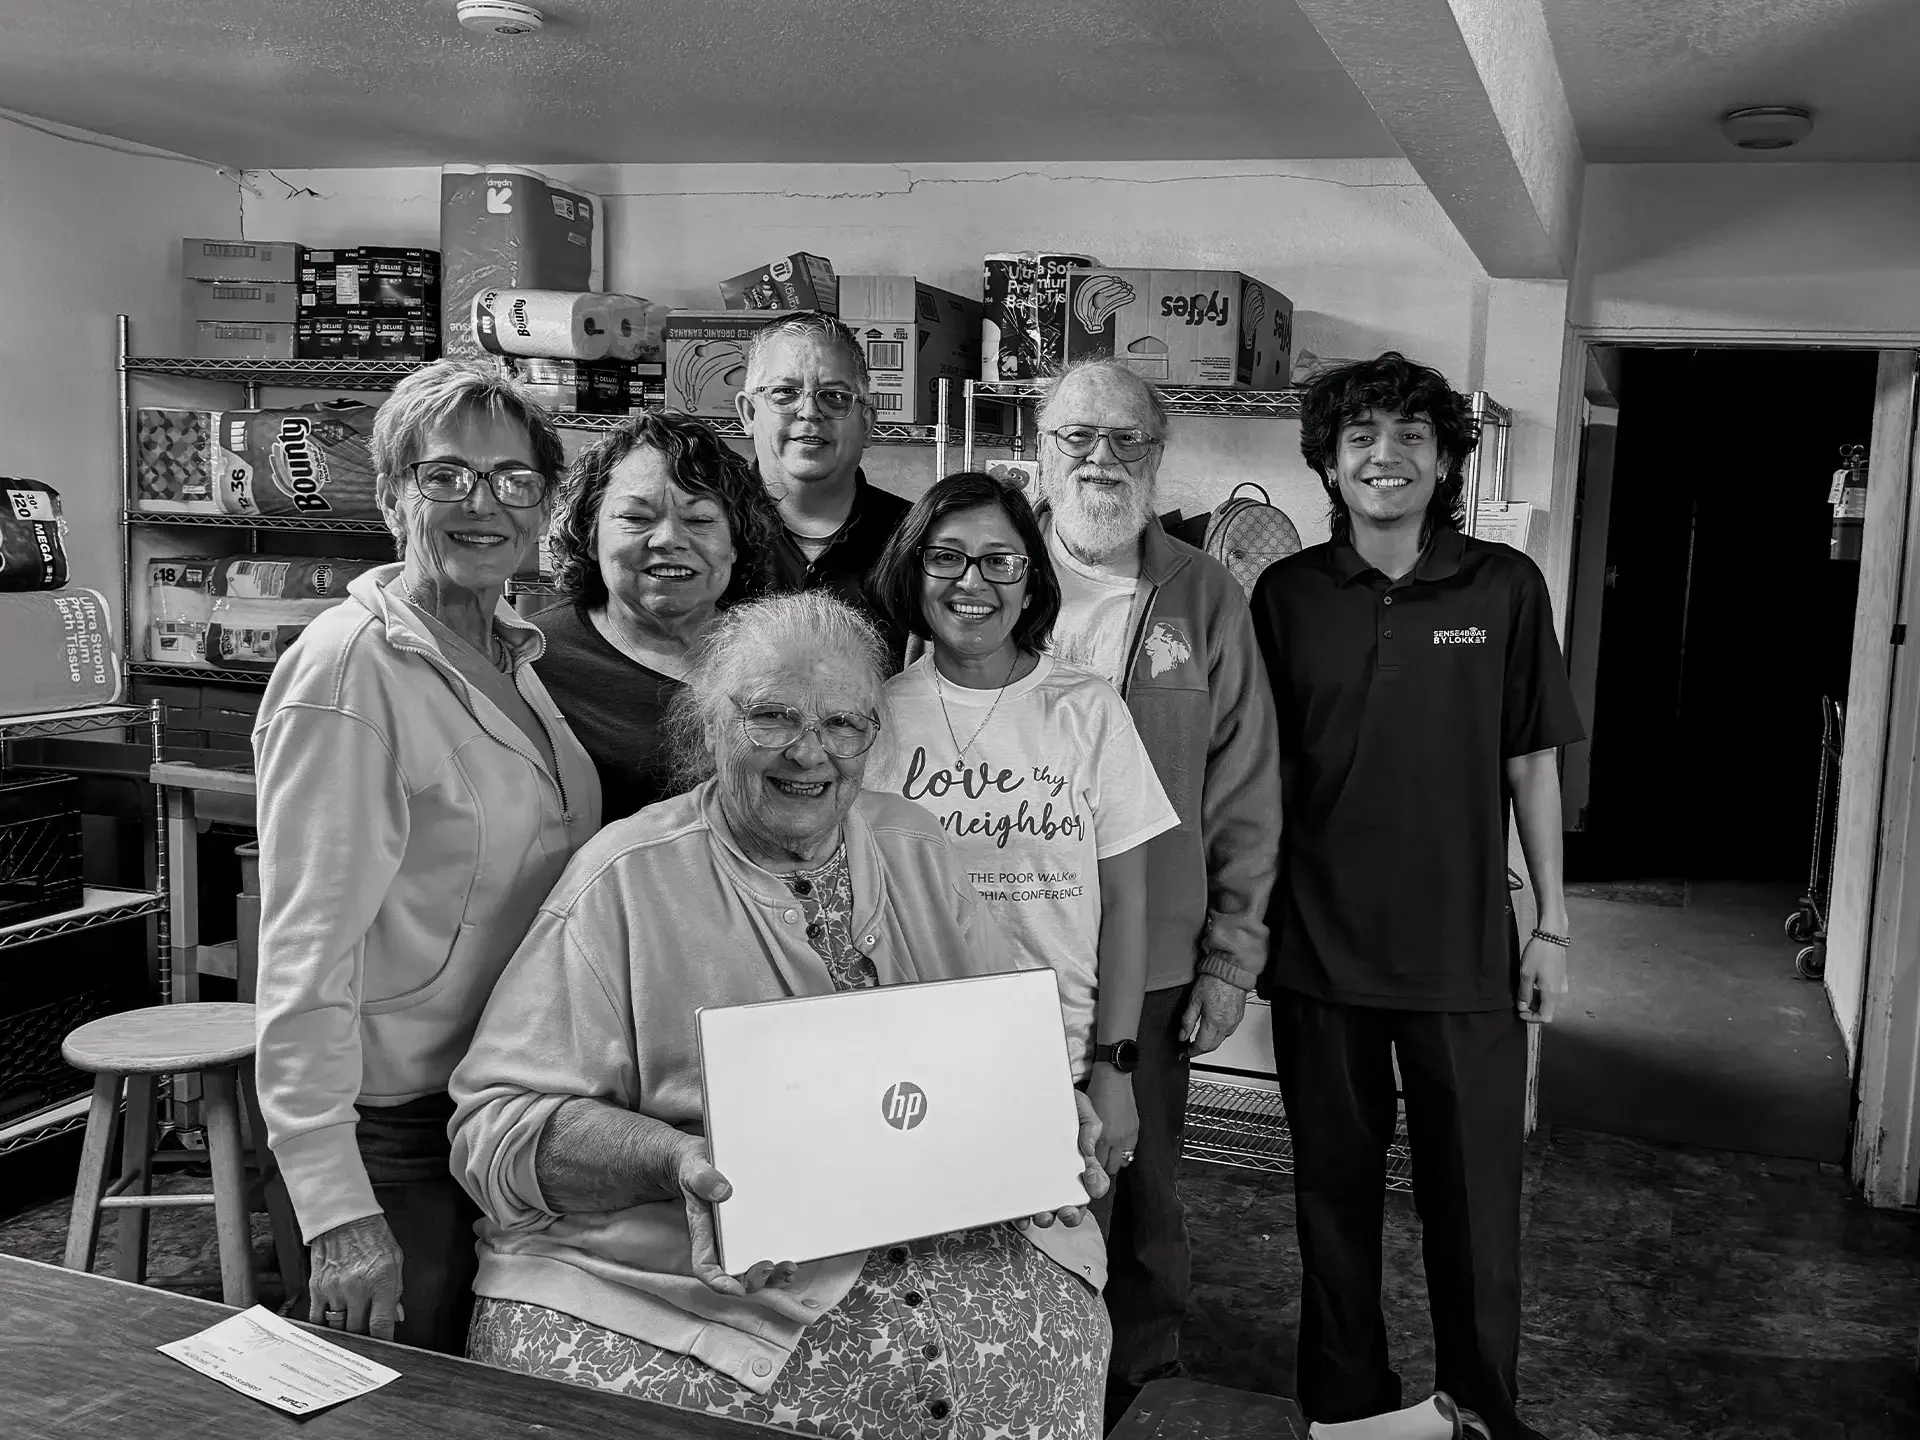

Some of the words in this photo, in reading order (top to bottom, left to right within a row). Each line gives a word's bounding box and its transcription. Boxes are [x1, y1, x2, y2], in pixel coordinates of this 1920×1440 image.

[773, 263, 786, 279] 10
[513, 299, 531, 336] Bounty
[669, 328, 702, 338] BANANAS
[704, 328, 735, 338] ORGANIC
[277, 418, 332, 512] Bounty
[13, 492, 32, 518] 120
[34, 523, 53, 562] MEGA
[316, 564, 331, 596] Bounty
[53, 598, 76, 630] Bath
[66, 633, 81, 682] Tissue
[65, 597, 90, 663] Premium
[78, 596, 97, 630] Ultra
[90, 633, 106, 684] Strong
[1433, 636, 1447, 644] BY
[1449, 636, 1487, 644] LOKKET
[902, 746, 1025, 800] love
[1031, 765, 1069, 797] thy
[968, 873, 995, 883] THE
[999, 872, 1034, 883] POOR
[1012, 886, 1083, 901] CONFERENCE
[885, 1082, 924, 1131] hp
